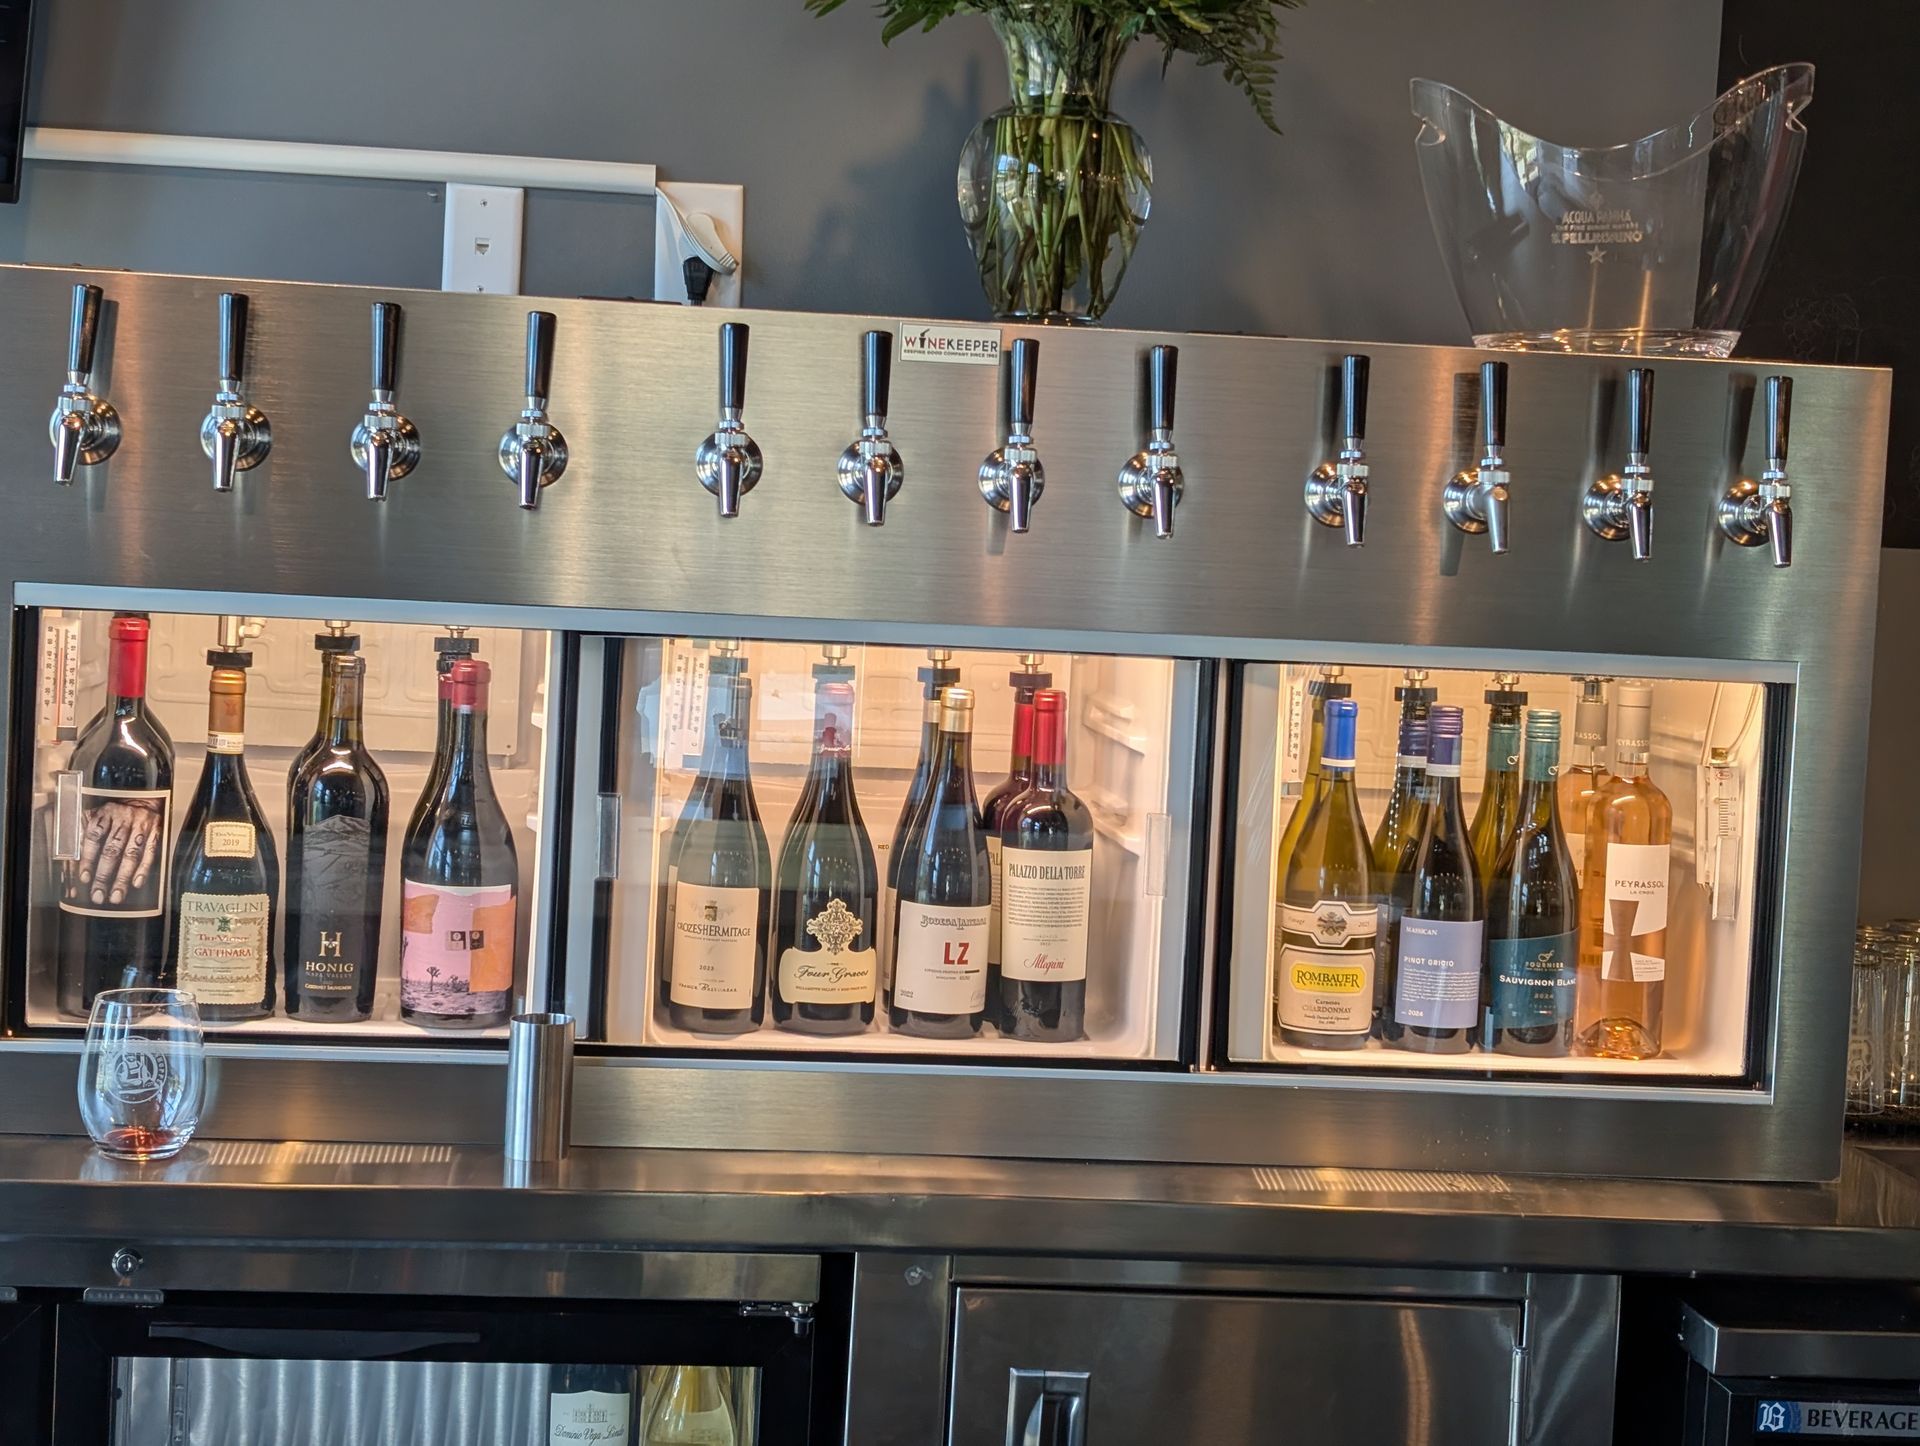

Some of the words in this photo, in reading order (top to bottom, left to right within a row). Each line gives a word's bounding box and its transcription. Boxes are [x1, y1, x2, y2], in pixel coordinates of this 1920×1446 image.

[904, 332, 998, 352] WINEKEEPER
[222, 838, 240, 847] 2019
[1008, 863, 1038, 880] PALAZZO
[1039, 865, 1063, 880] DELLA
[1065, 866, 1085, 880] TORRE
[1614, 879, 1665, 889] PEYRASSOL
[187, 900, 264, 913] TRAVAGLINI
[194, 948, 252, 958] GATTINARA
[943, 942, 970, 965] LZ
[305, 961, 354, 973] HONIG
[1403, 955, 1425, 965] PINOT
[1427, 959, 1455, 967] GRIGIO
[1525, 961, 1564, 969] FOURNIER
[1296, 969, 1360, 989] ROMBAUER
[1500, 974, 1555, 987] SAUVIGNON
[1302, 1004, 1352, 1014] CHARDONNAY
[1407, 1009, 1424, 1017] 2024
[1807, 1409, 1919, 1431] BEVERAGE
